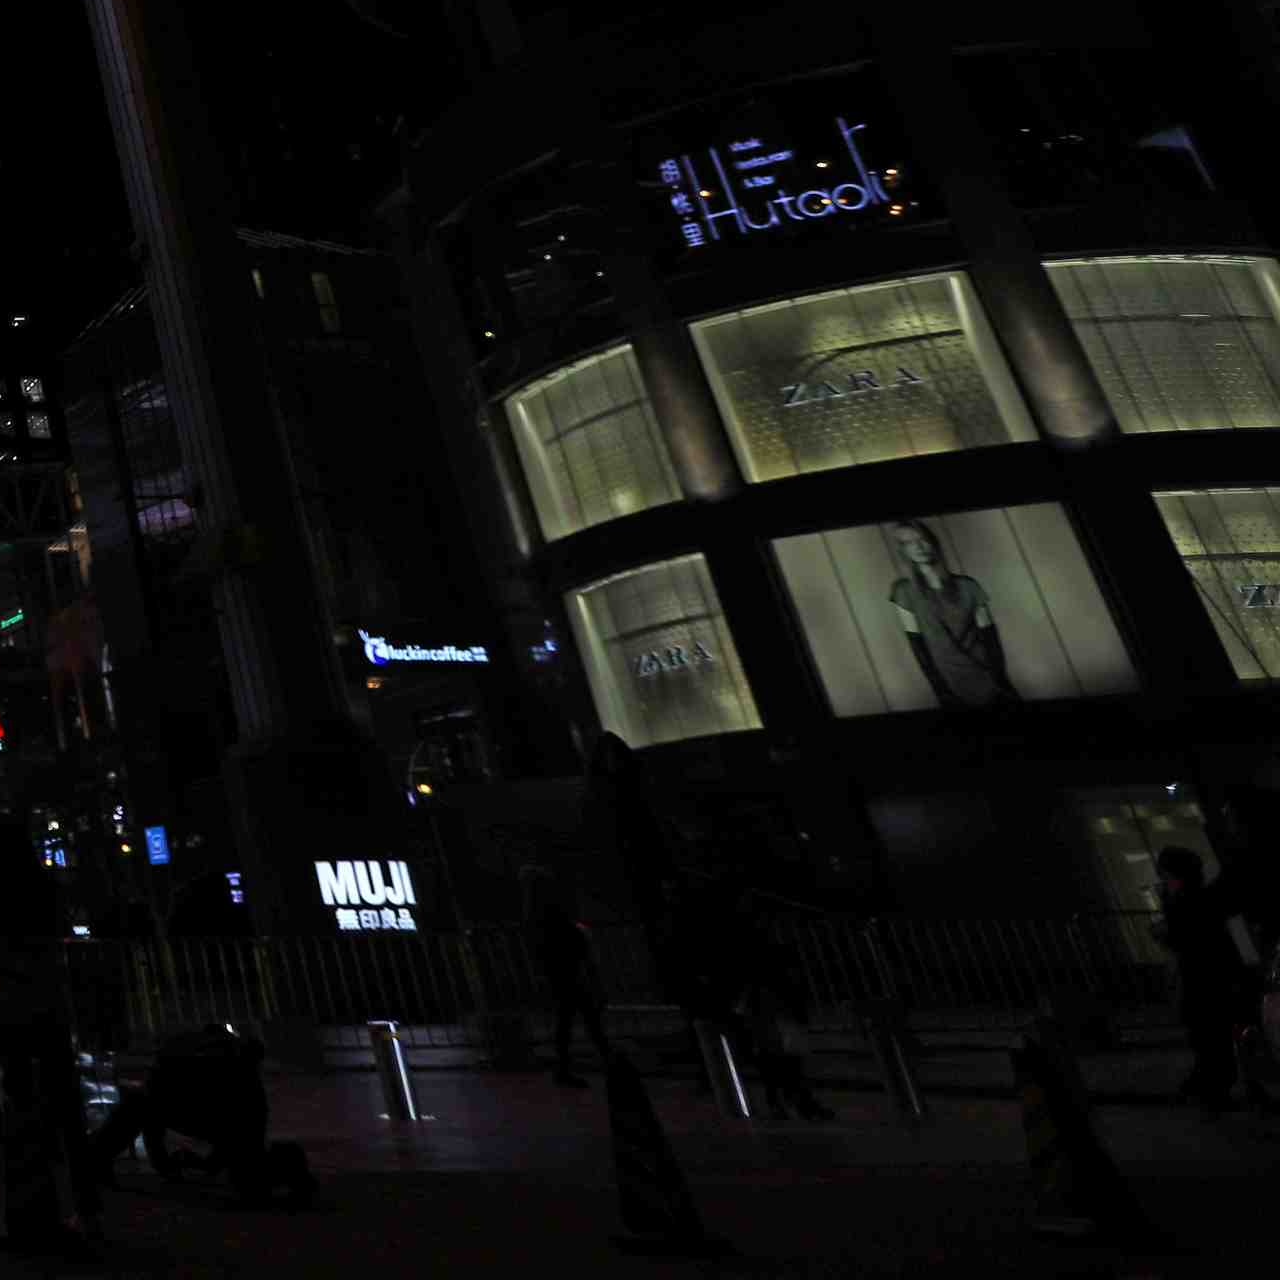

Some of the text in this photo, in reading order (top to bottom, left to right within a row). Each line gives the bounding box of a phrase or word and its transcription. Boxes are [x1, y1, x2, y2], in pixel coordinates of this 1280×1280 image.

[780, 368, 924, 407] ZARA
[637, 641, 714, 678] ZARA
[314, 860, 417, 906] MUJI
[336, 907, 418, 931] 無印良品
